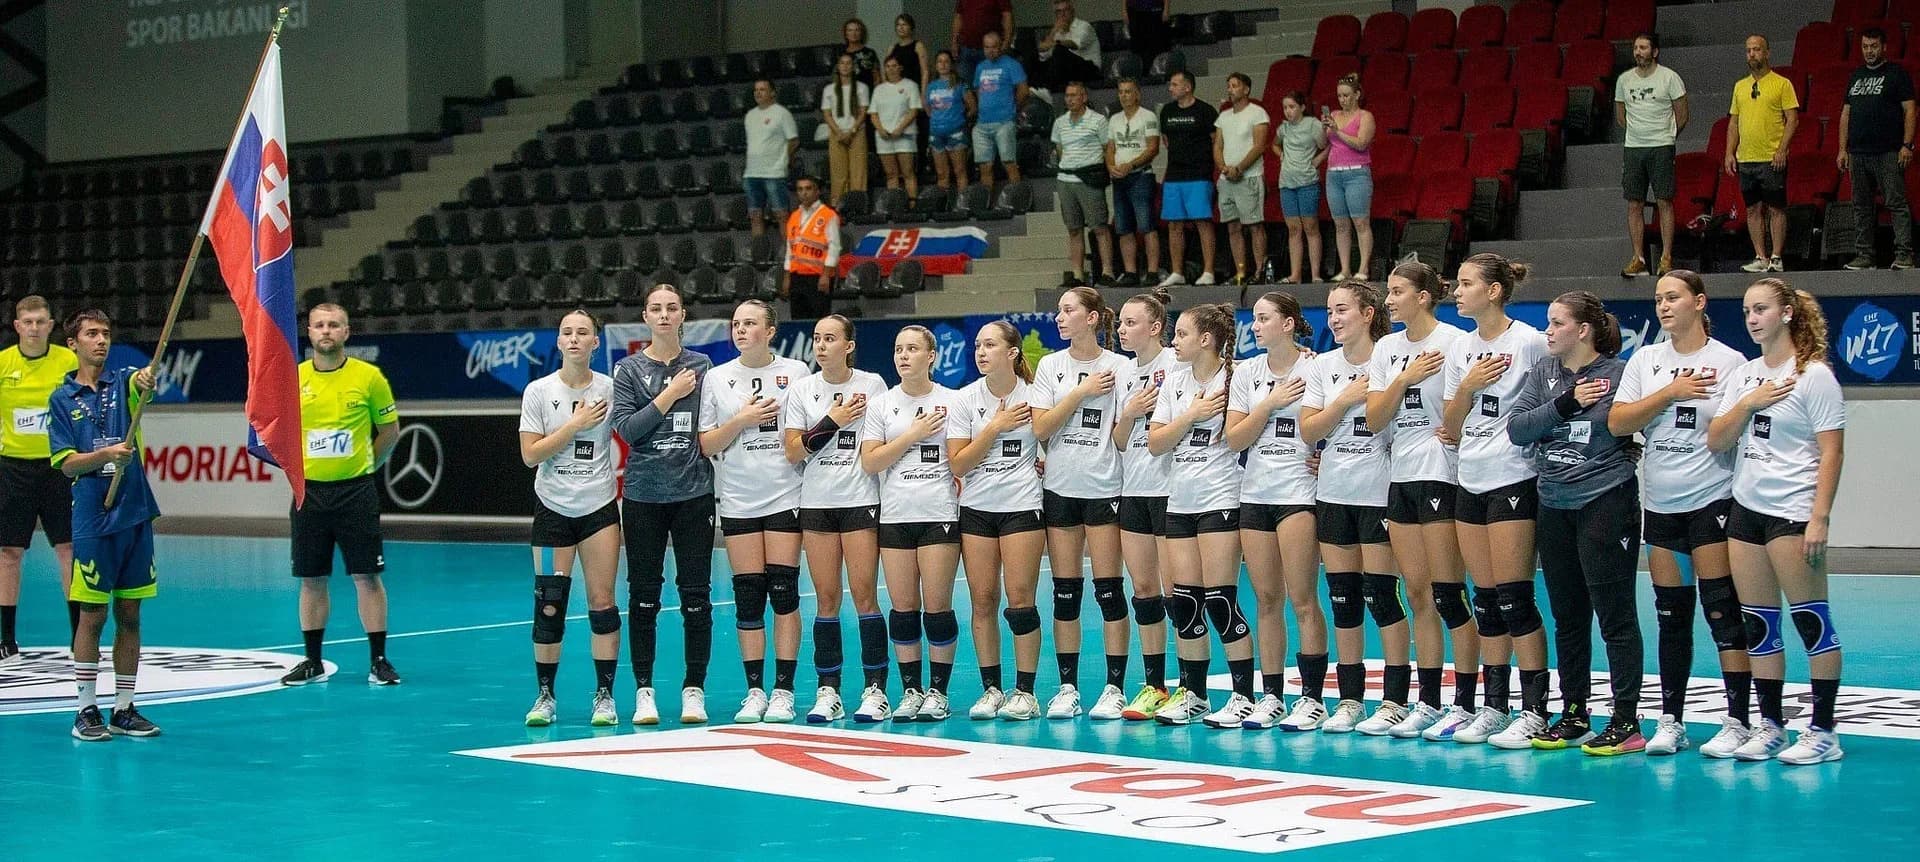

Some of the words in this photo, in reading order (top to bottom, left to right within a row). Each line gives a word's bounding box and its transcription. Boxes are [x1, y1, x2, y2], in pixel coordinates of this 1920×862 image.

[126, 15, 183, 48] SPOR
[466, 332, 543, 379] CHEER
[17, 415, 35, 426] EHF
[309, 437, 329, 449] EHF
[330, 431, 350, 454] TV
[970, 762, 1530, 825] raru
